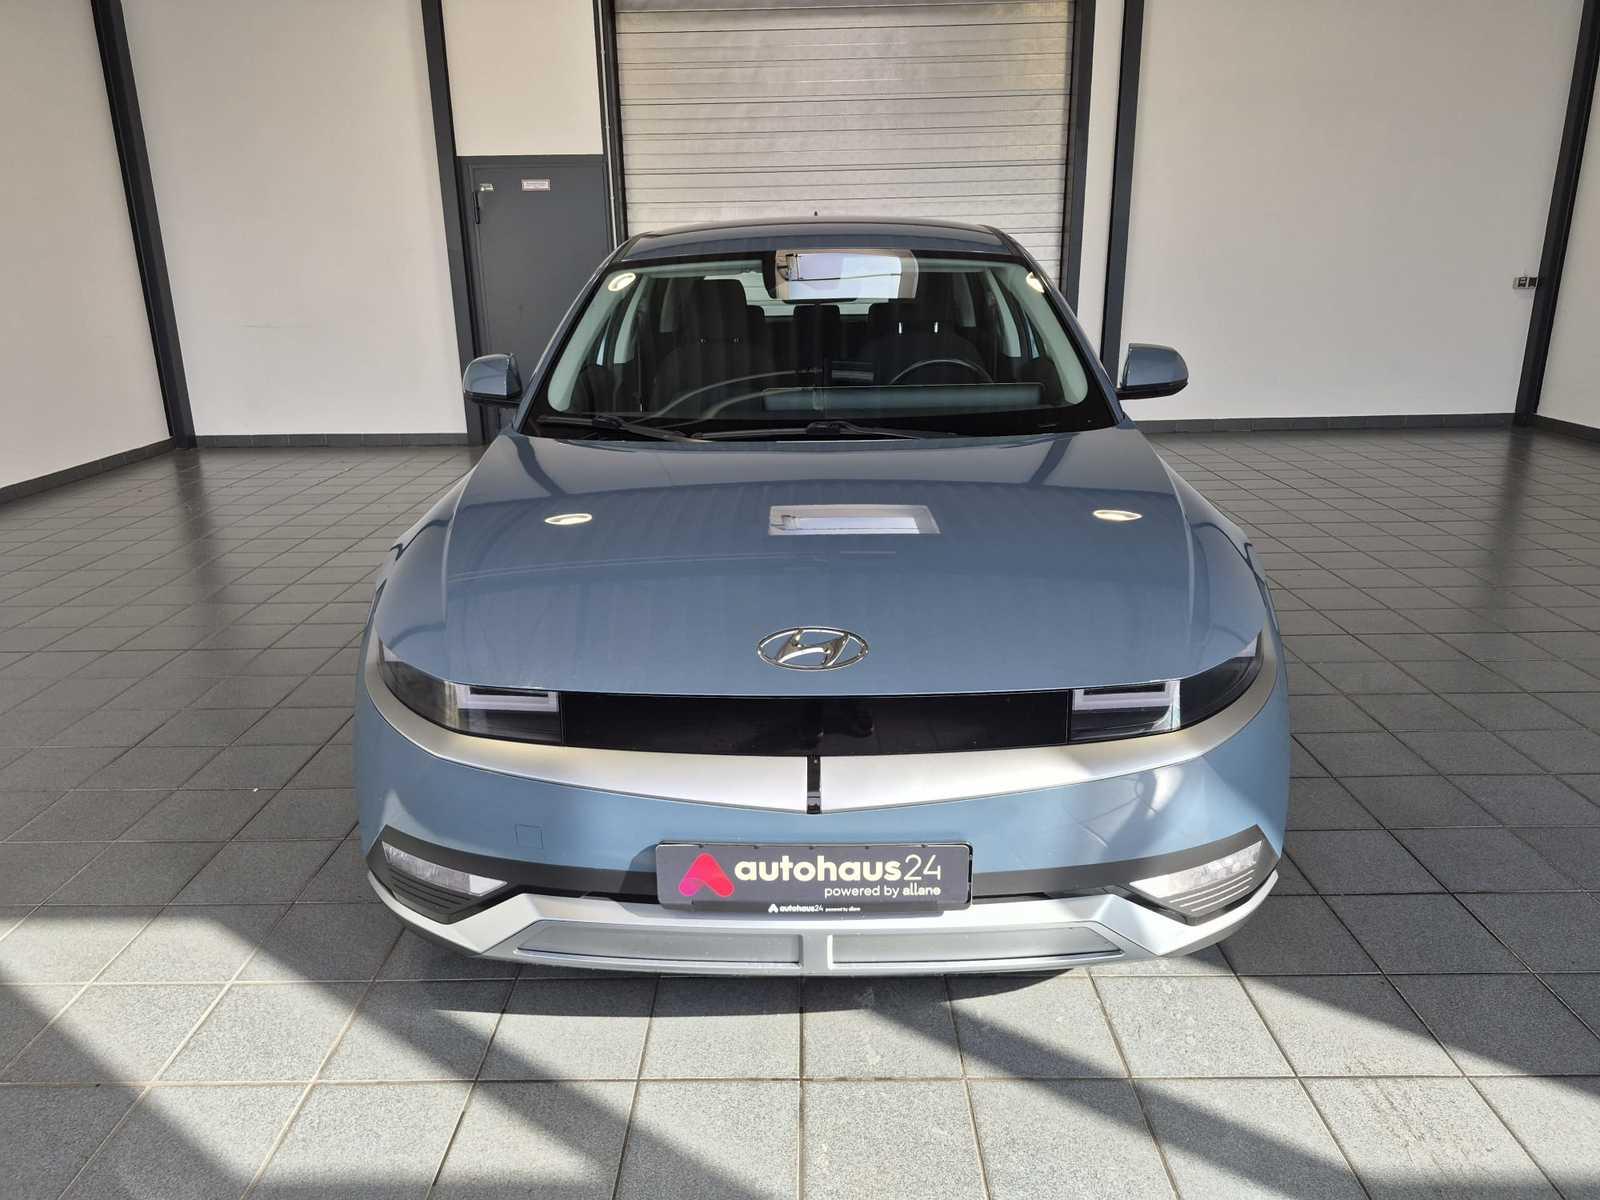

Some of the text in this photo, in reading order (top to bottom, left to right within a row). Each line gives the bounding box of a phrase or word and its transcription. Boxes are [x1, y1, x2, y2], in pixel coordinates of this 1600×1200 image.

[734, 854, 942, 882] autohaus24
[824, 884, 881, 899] powered
[884, 882, 900, 899] by
